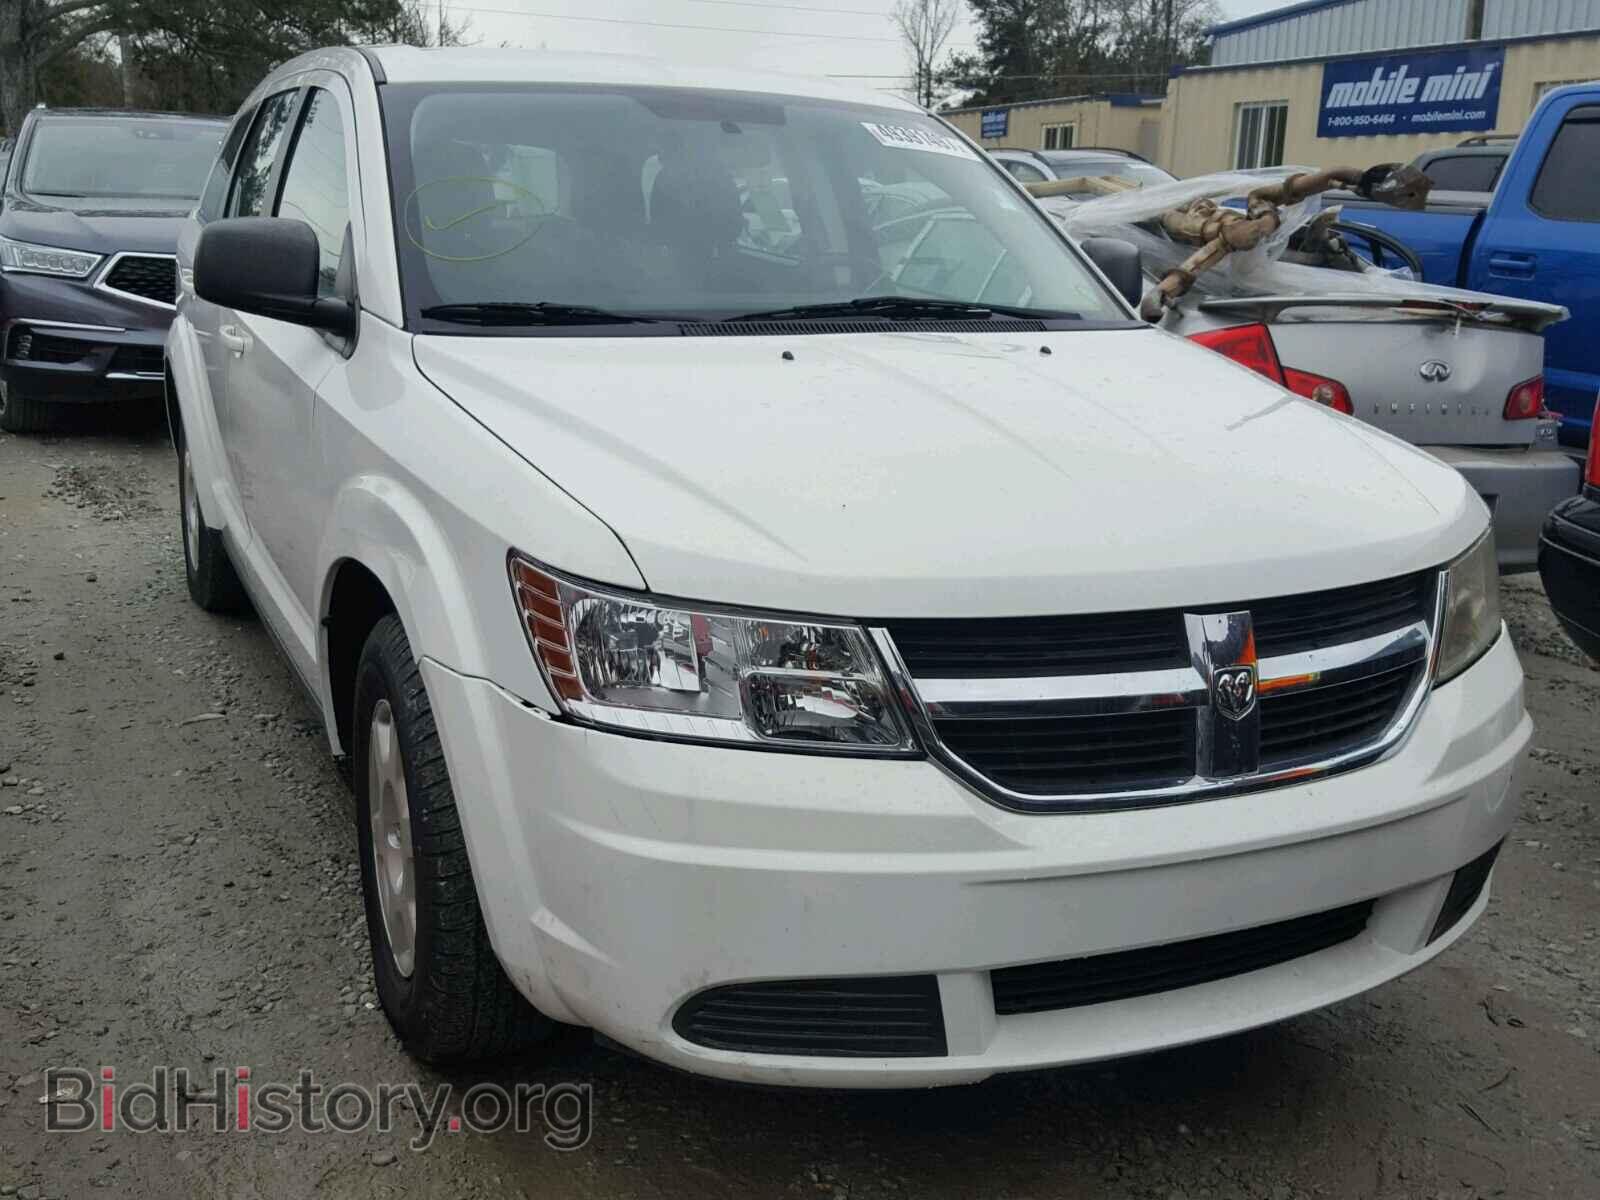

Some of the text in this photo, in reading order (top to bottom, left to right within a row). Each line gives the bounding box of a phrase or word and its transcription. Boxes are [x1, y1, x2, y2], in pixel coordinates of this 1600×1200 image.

[1326, 64, 1493, 108] mobile mini
[1327, 110, 1486, 126] 1-800-950-6464 mobilemini.com
